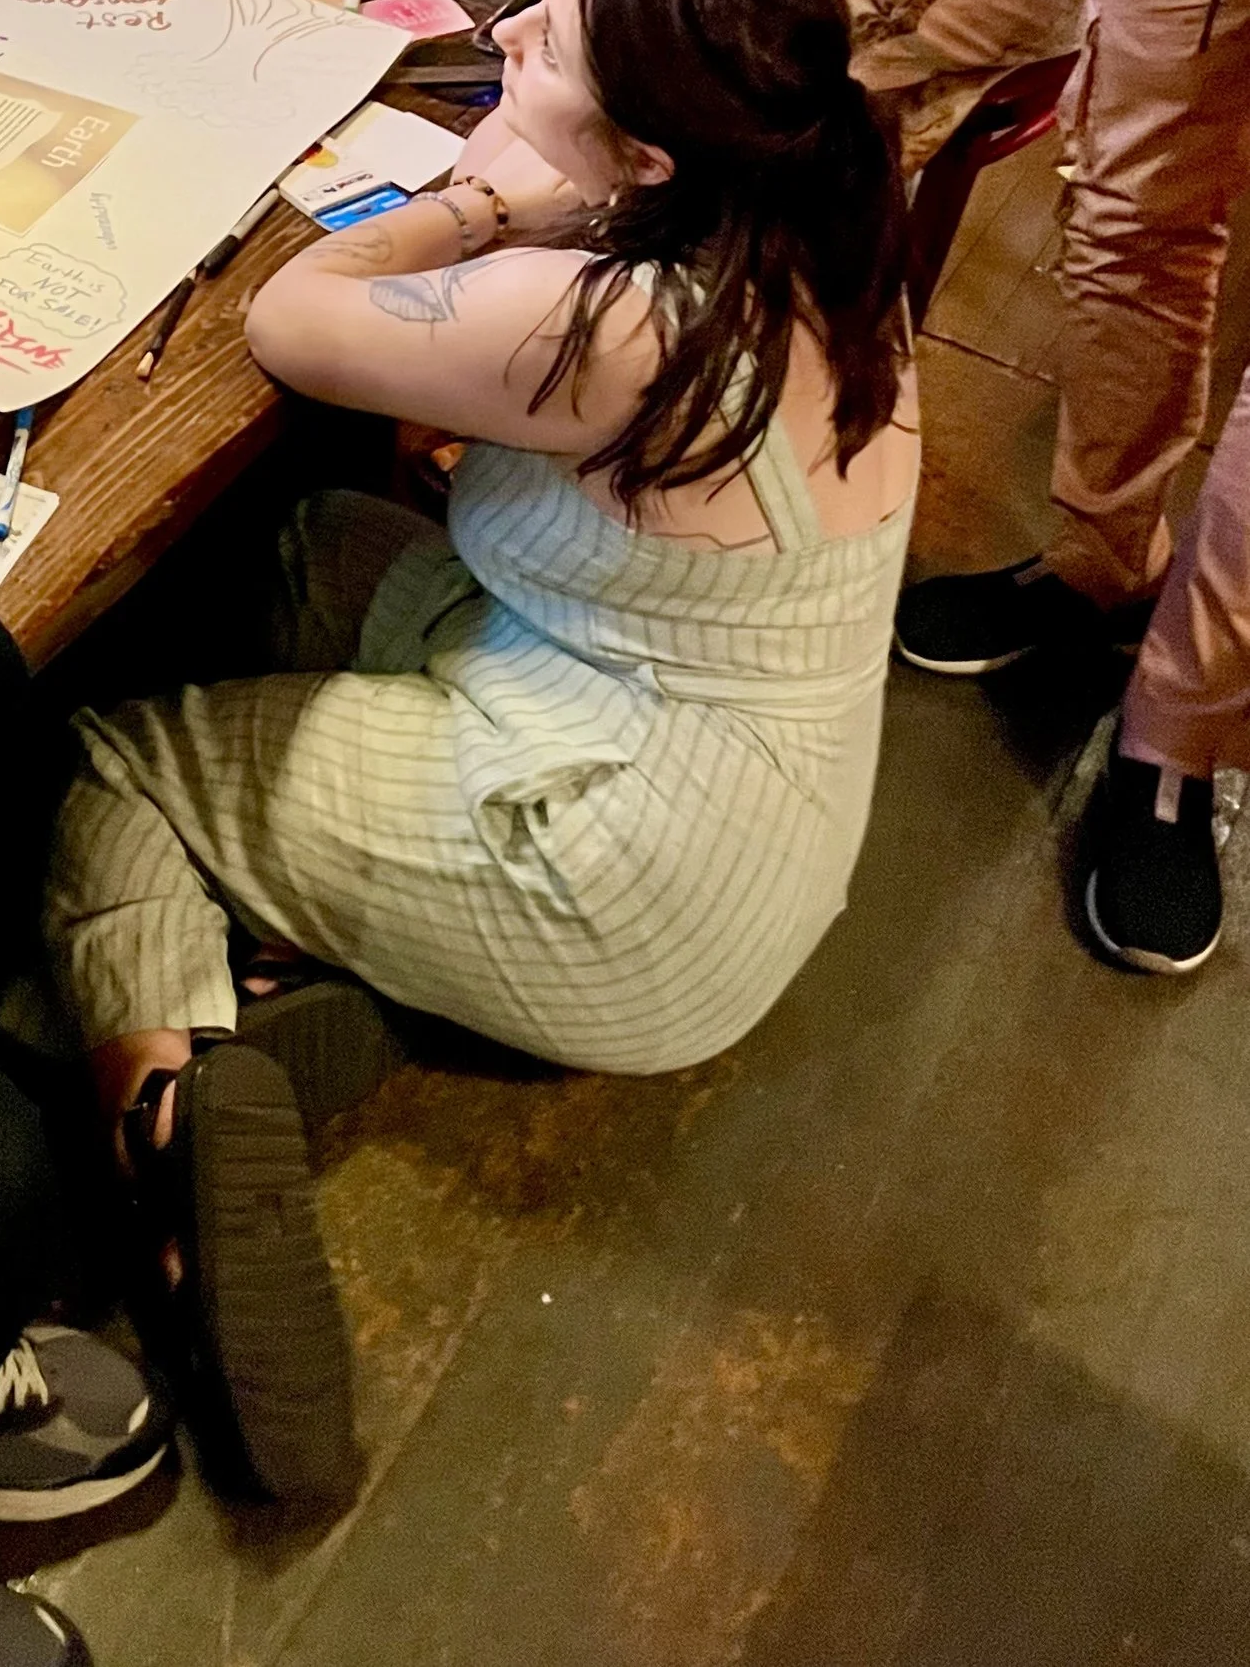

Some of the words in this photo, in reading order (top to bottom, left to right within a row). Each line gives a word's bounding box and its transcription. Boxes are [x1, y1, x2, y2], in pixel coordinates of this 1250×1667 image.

[76, 10, 171, 31] Rest
[41, 115, 110, 169] Earth
[25, 251, 84, 283] Earth
[34, 277, 91, 300] NOT
[38, 298, 102, 332] SALE!
